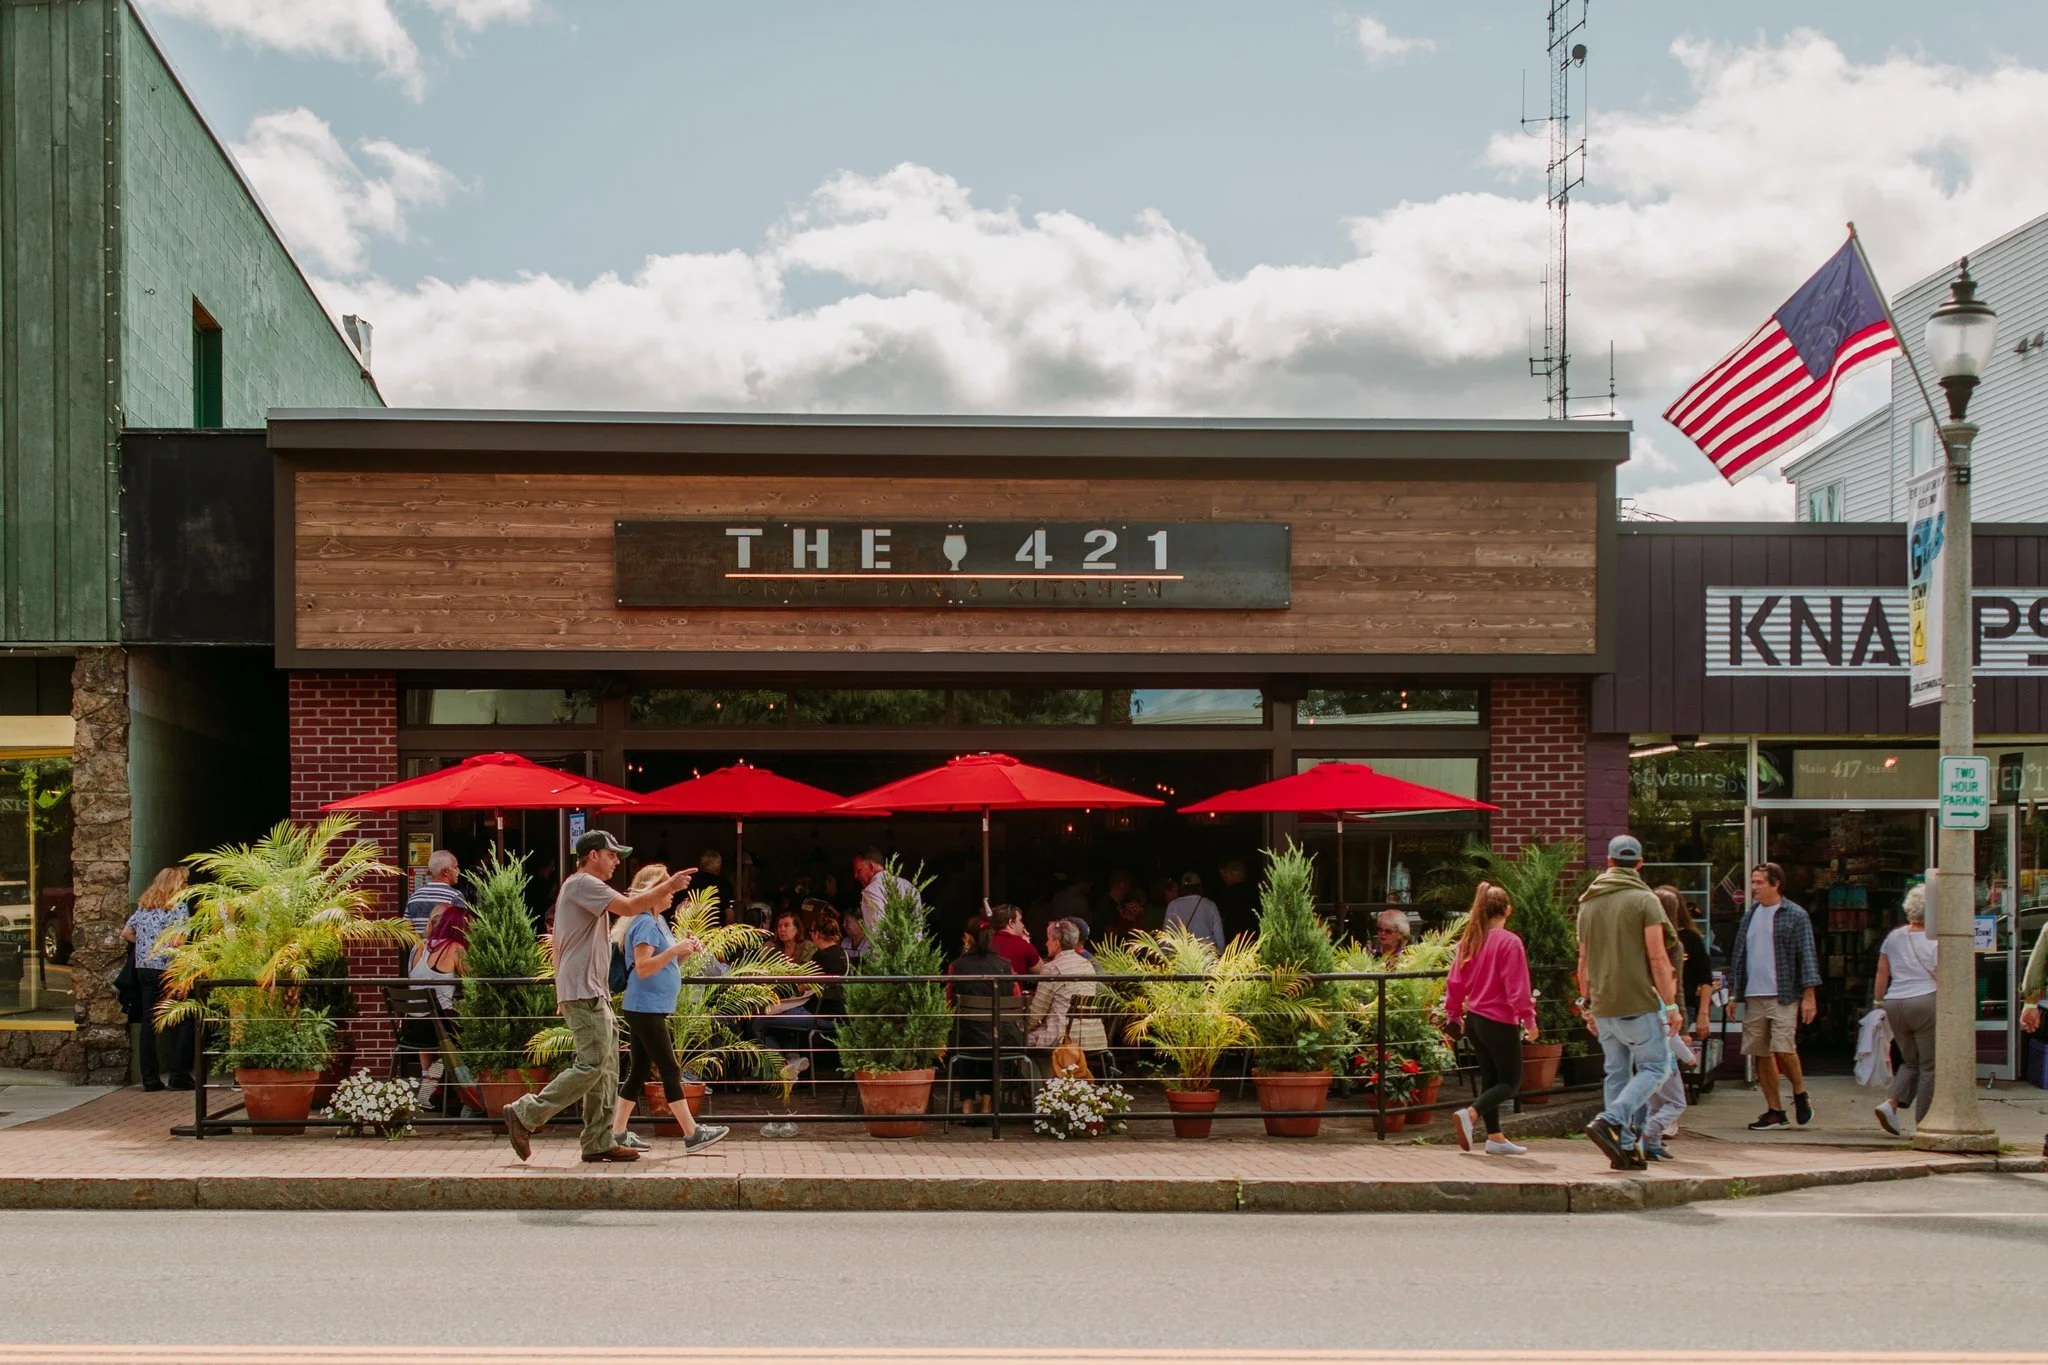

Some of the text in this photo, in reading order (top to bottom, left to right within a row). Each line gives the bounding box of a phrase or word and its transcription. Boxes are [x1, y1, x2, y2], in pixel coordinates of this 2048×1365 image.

[725, 528, 1168, 570] THE 421
[737, 579, 1162, 599] CRAFT BAR & KITCHEN
[1729, 596, 2048, 666] KNAP
[1629, 767, 1727, 789] ouvenirs
[1799, 759, 1898, 779] Main 417 Street
[1955, 767, 1976, 779] TWO
[1951, 781, 1979, 793] HOUR
[1943, 795, 1986, 807] PARKING
